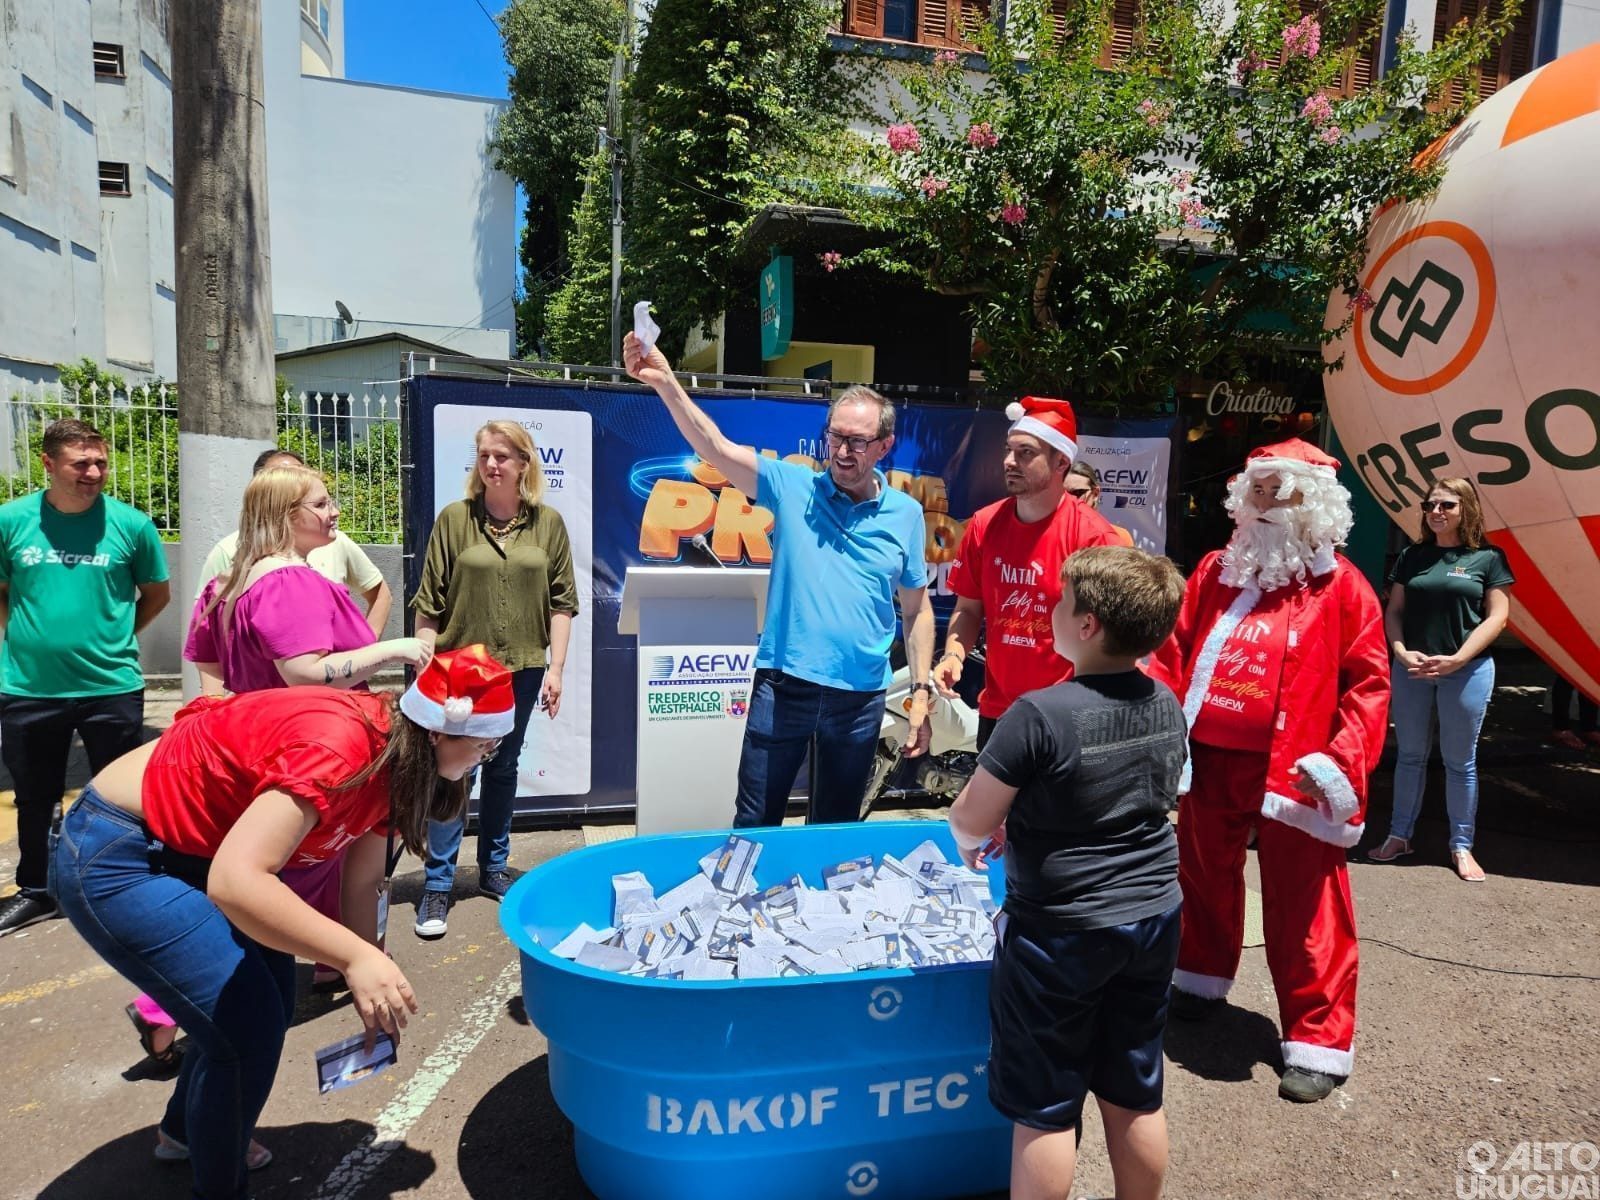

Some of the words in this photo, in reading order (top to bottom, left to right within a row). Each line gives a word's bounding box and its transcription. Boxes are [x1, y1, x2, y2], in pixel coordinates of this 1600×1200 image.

[1207, 381, 1296, 416] Criativa
[1129, 496, 1147, 506] CDL
[45, 550, 110, 567] Sicredi
[1001, 564, 1037, 585] NATAL
[678, 654, 750, 673] AEFW
[1248, 664, 1266, 676] COM
[648, 691, 721, 704] FREDERICO
[1210, 695, 1245, 711] AEFW
[649, 702, 721, 714] WESTPHALEN
[646, 1087, 838, 1136] BAKOF
[868, 1072, 969, 1118] TEC
